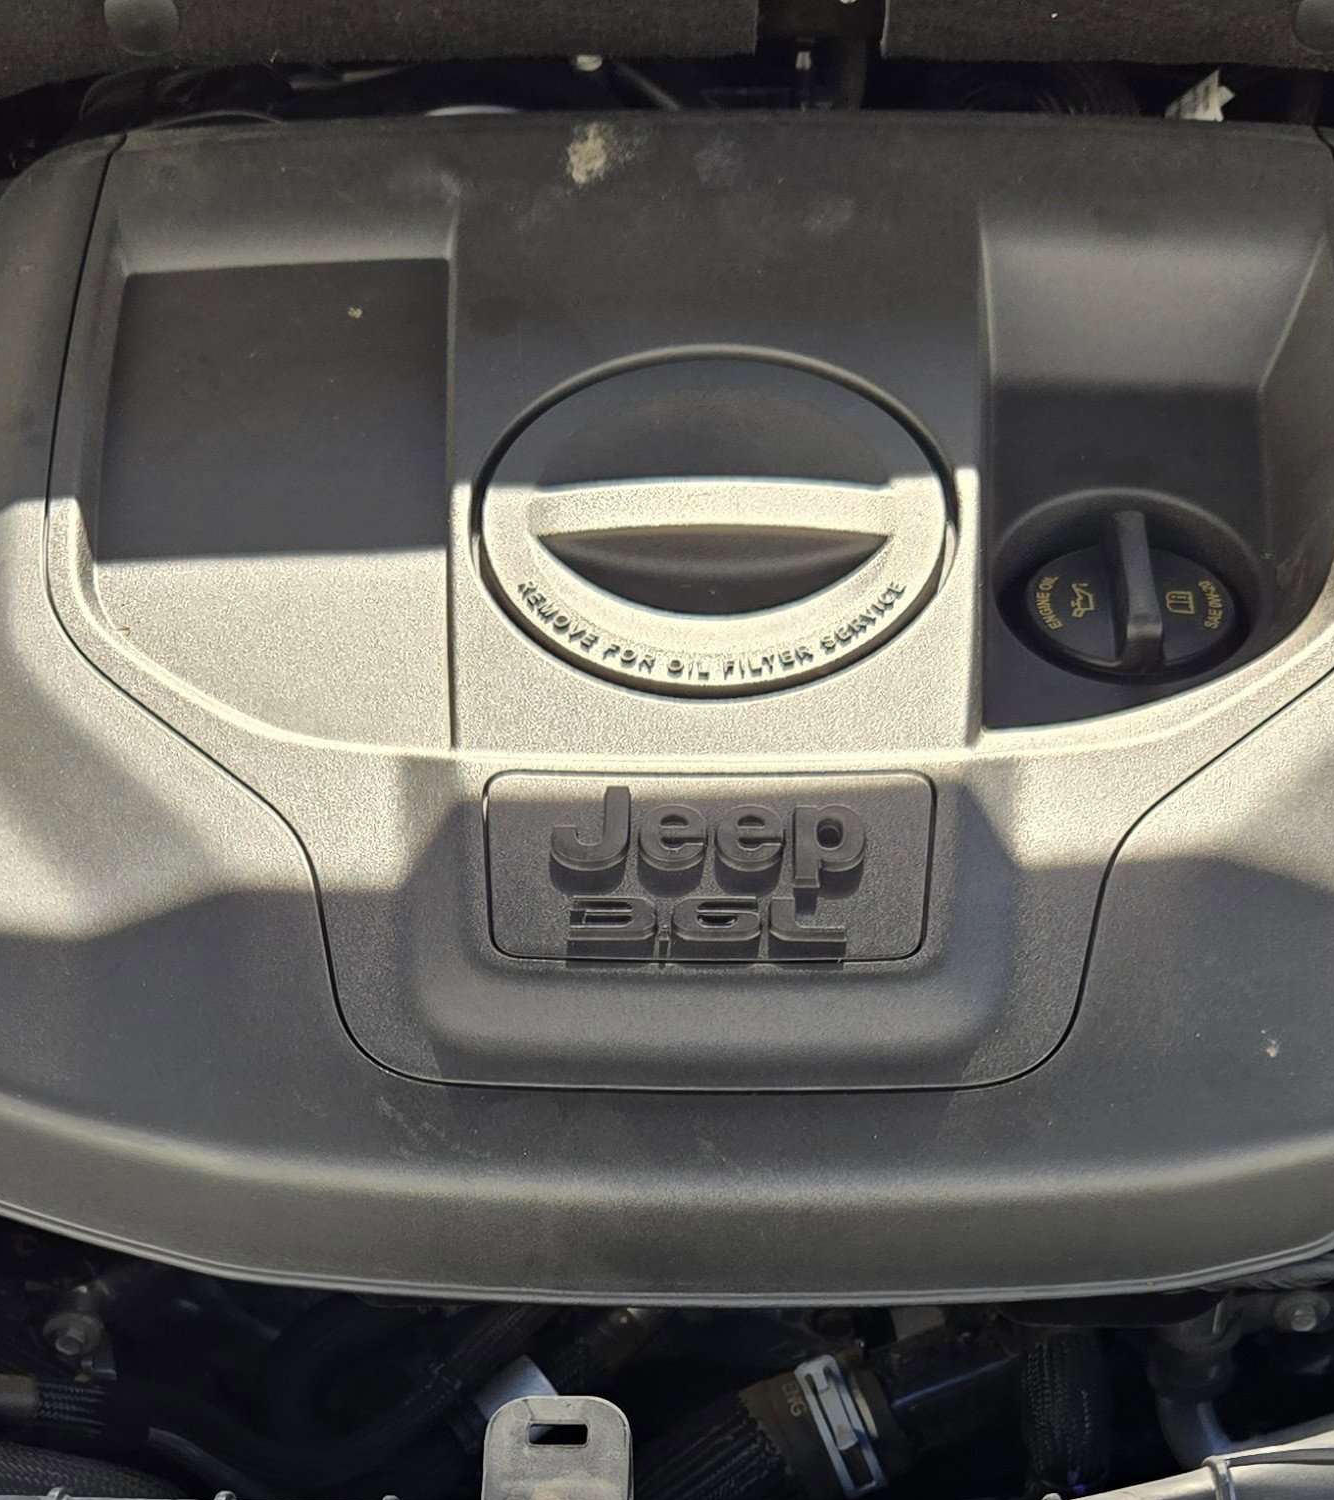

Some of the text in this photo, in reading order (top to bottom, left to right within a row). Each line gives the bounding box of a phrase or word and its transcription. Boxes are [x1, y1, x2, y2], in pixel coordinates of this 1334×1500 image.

[1036, 575, 1063, 630] ENGINE OIL
[1203, 609, 1223, 630] SAE
[516, 580, 909, 681] REMOVE FOR OIL FILTER SERVICE
[550, 785, 866, 889] Jeep
[567, 894, 848, 943] 3.6L
